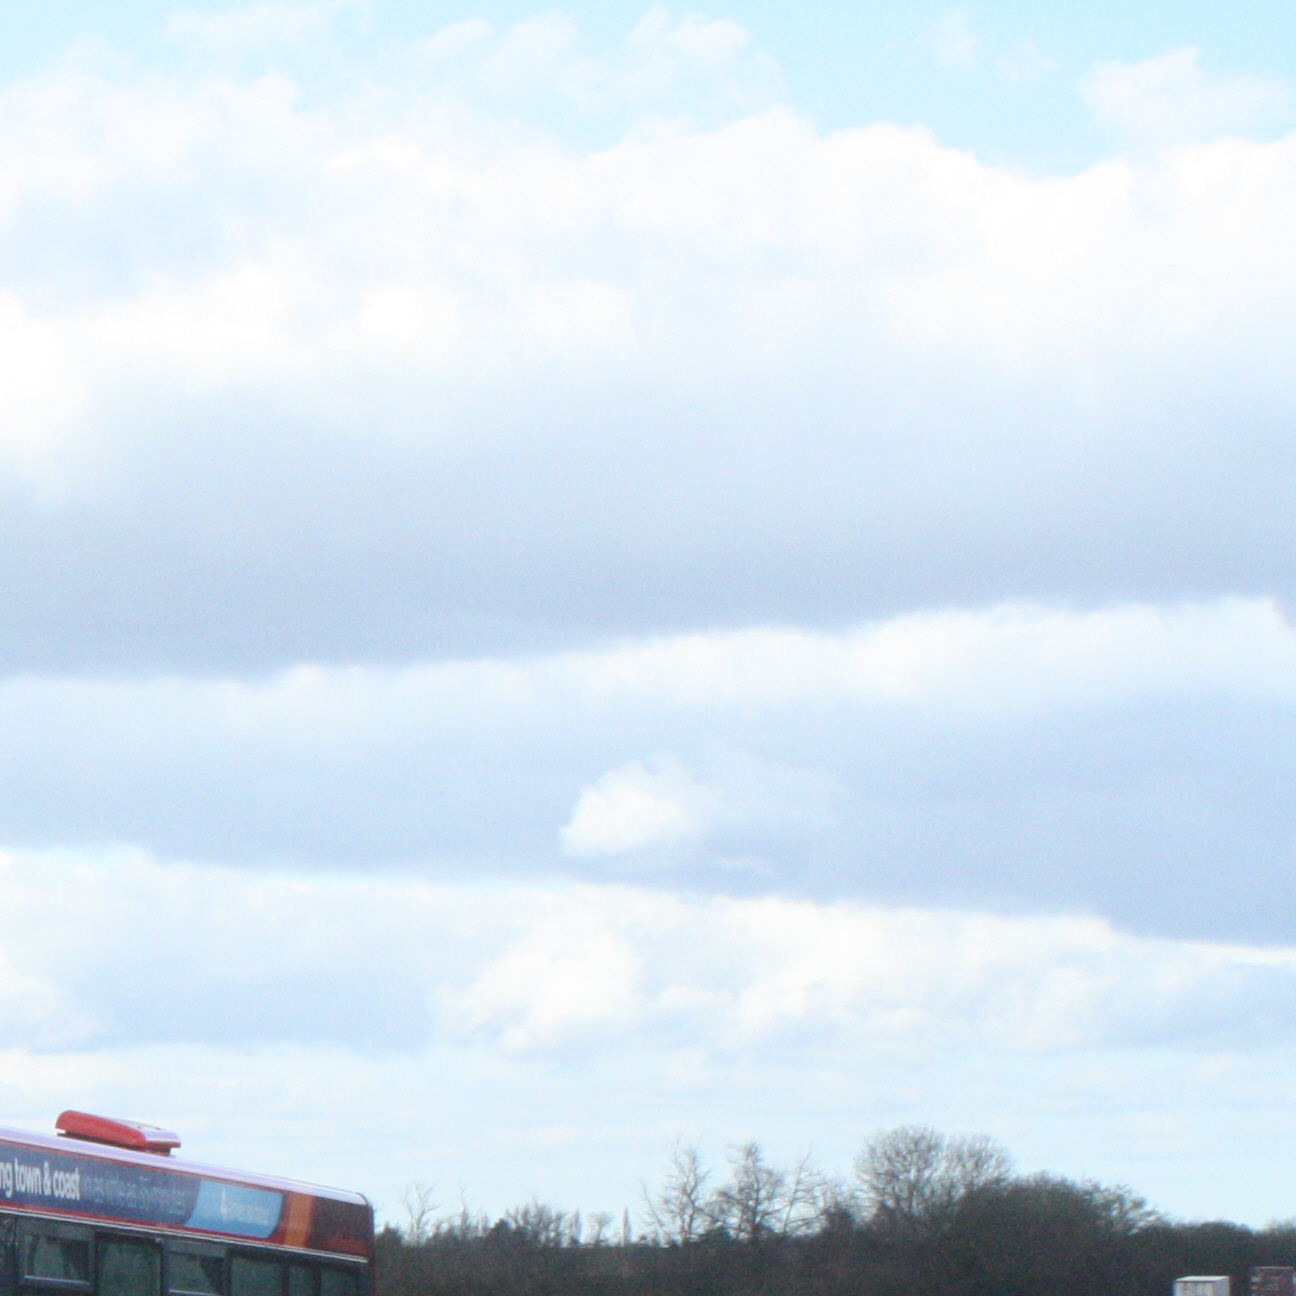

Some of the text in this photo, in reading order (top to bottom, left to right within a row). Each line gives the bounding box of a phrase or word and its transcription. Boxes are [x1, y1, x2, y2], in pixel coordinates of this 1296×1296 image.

[14, 1158, 43, 1194] town
[43, 1161, 51, 1196] &
[53, 1167, 81, 1201] coast
